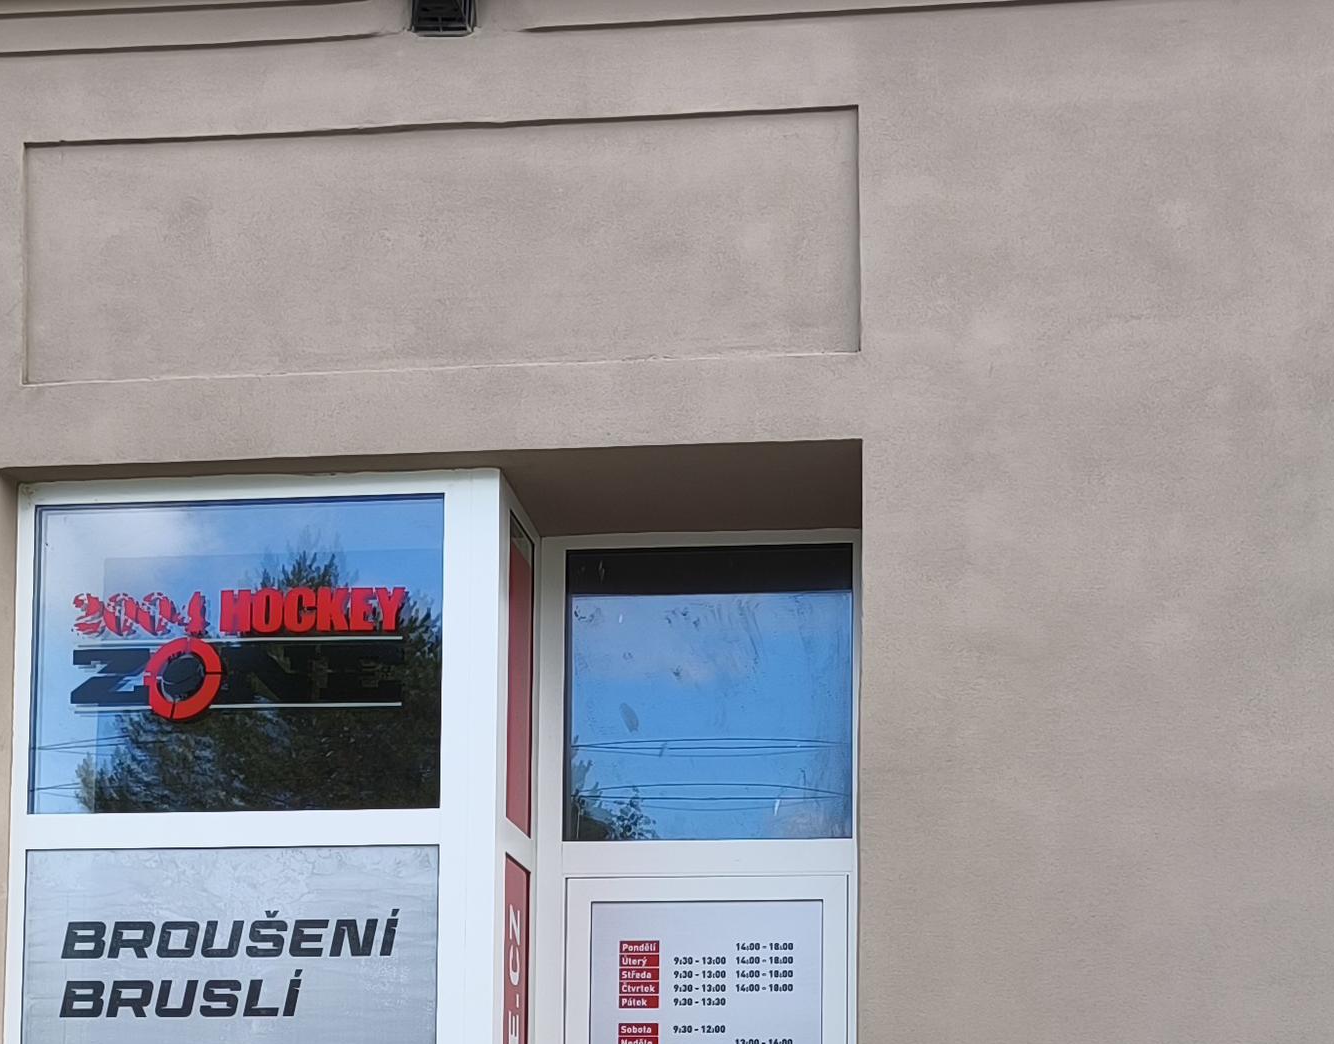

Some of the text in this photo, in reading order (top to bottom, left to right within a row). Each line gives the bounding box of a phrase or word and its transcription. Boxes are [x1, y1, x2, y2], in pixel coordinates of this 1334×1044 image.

[71, 586, 408, 637] 2004 HOCKEY
[59, 908, 401, 960] BROUŠENÍ
[58, 968, 303, 1018] BRUSLÍ
